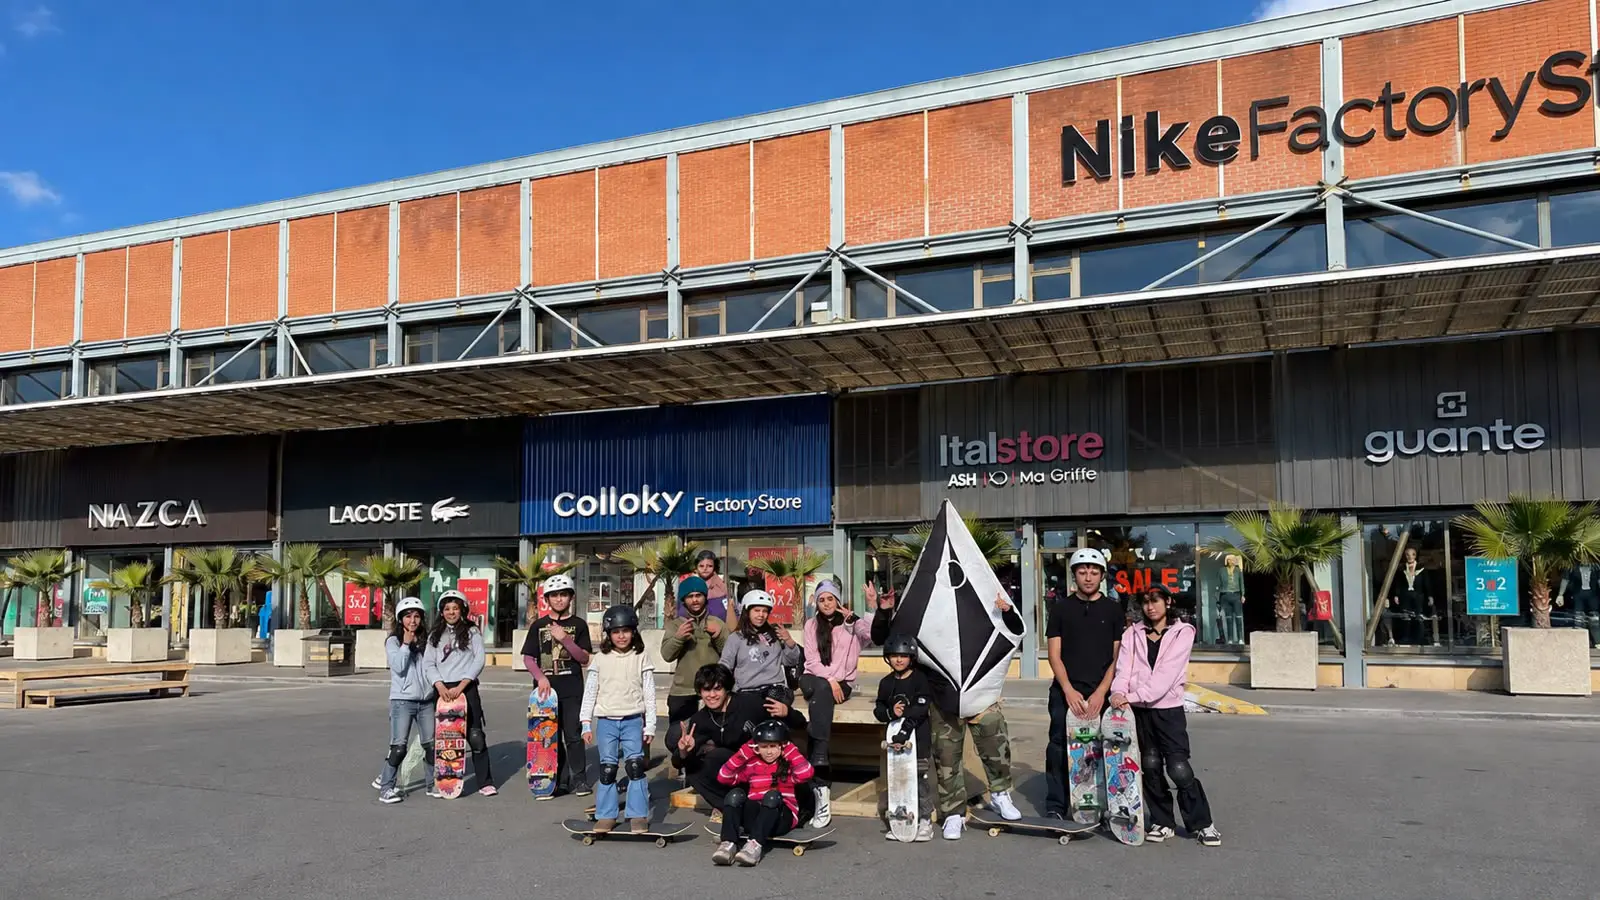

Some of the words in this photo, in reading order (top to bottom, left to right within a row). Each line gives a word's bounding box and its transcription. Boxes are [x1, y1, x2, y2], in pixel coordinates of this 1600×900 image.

[939, 431, 1104, 467] Italstore
[1364, 418, 1546, 463] guante
[948, 473, 977, 487] ASH
[1020, 471, 1045, 483] Ma
[1050, 467, 1098, 483] Griffe
[88, 499, 207, 529] NAZCA
[329, 502, 423, 524] LACOSTE
[553, 484, 684, 518] Colloky
[348, 594, 367, 609] 3x2
